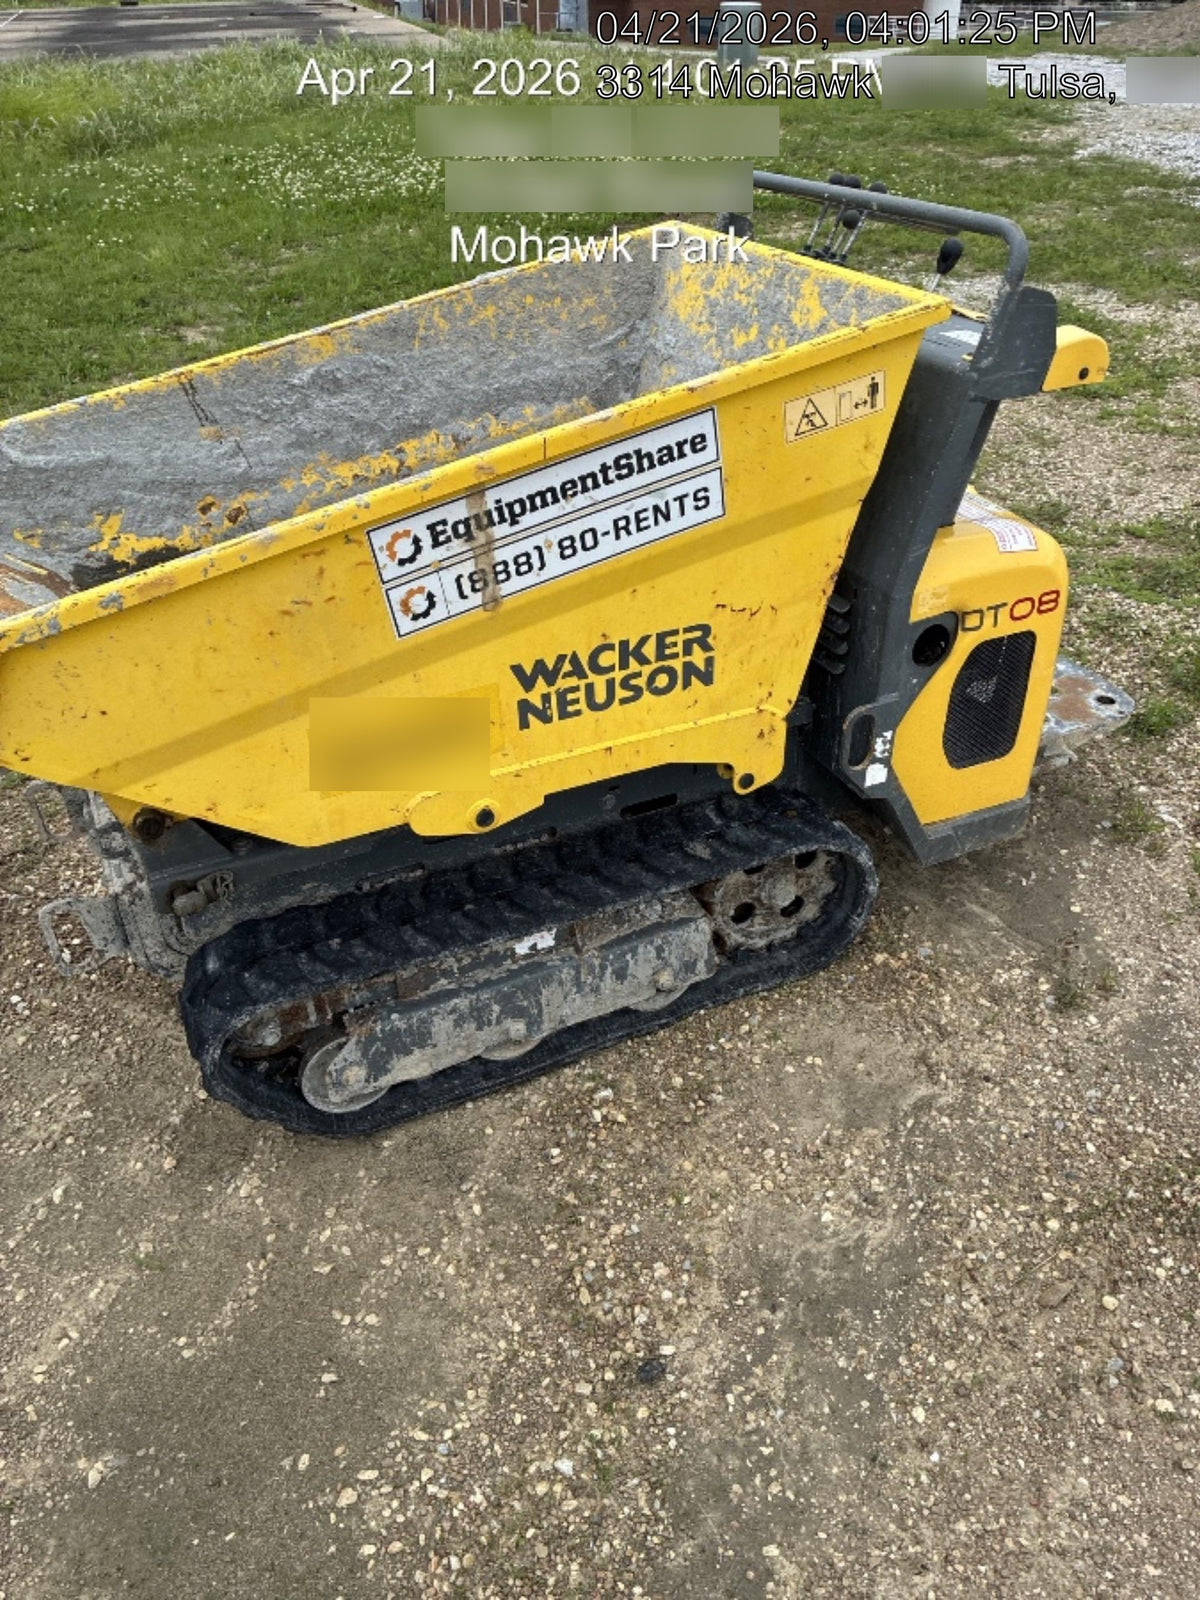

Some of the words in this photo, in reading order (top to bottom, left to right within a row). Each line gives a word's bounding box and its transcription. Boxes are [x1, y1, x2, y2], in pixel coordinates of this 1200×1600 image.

[426, 431, 708, 550] EquipmentShare
[454, 544, 546, 601] (888)
[557, 486, 711, 561] 80-RENTS
[510, 623, 715, 693] WACKER
[517, 655, 714, 731] NEUSON
